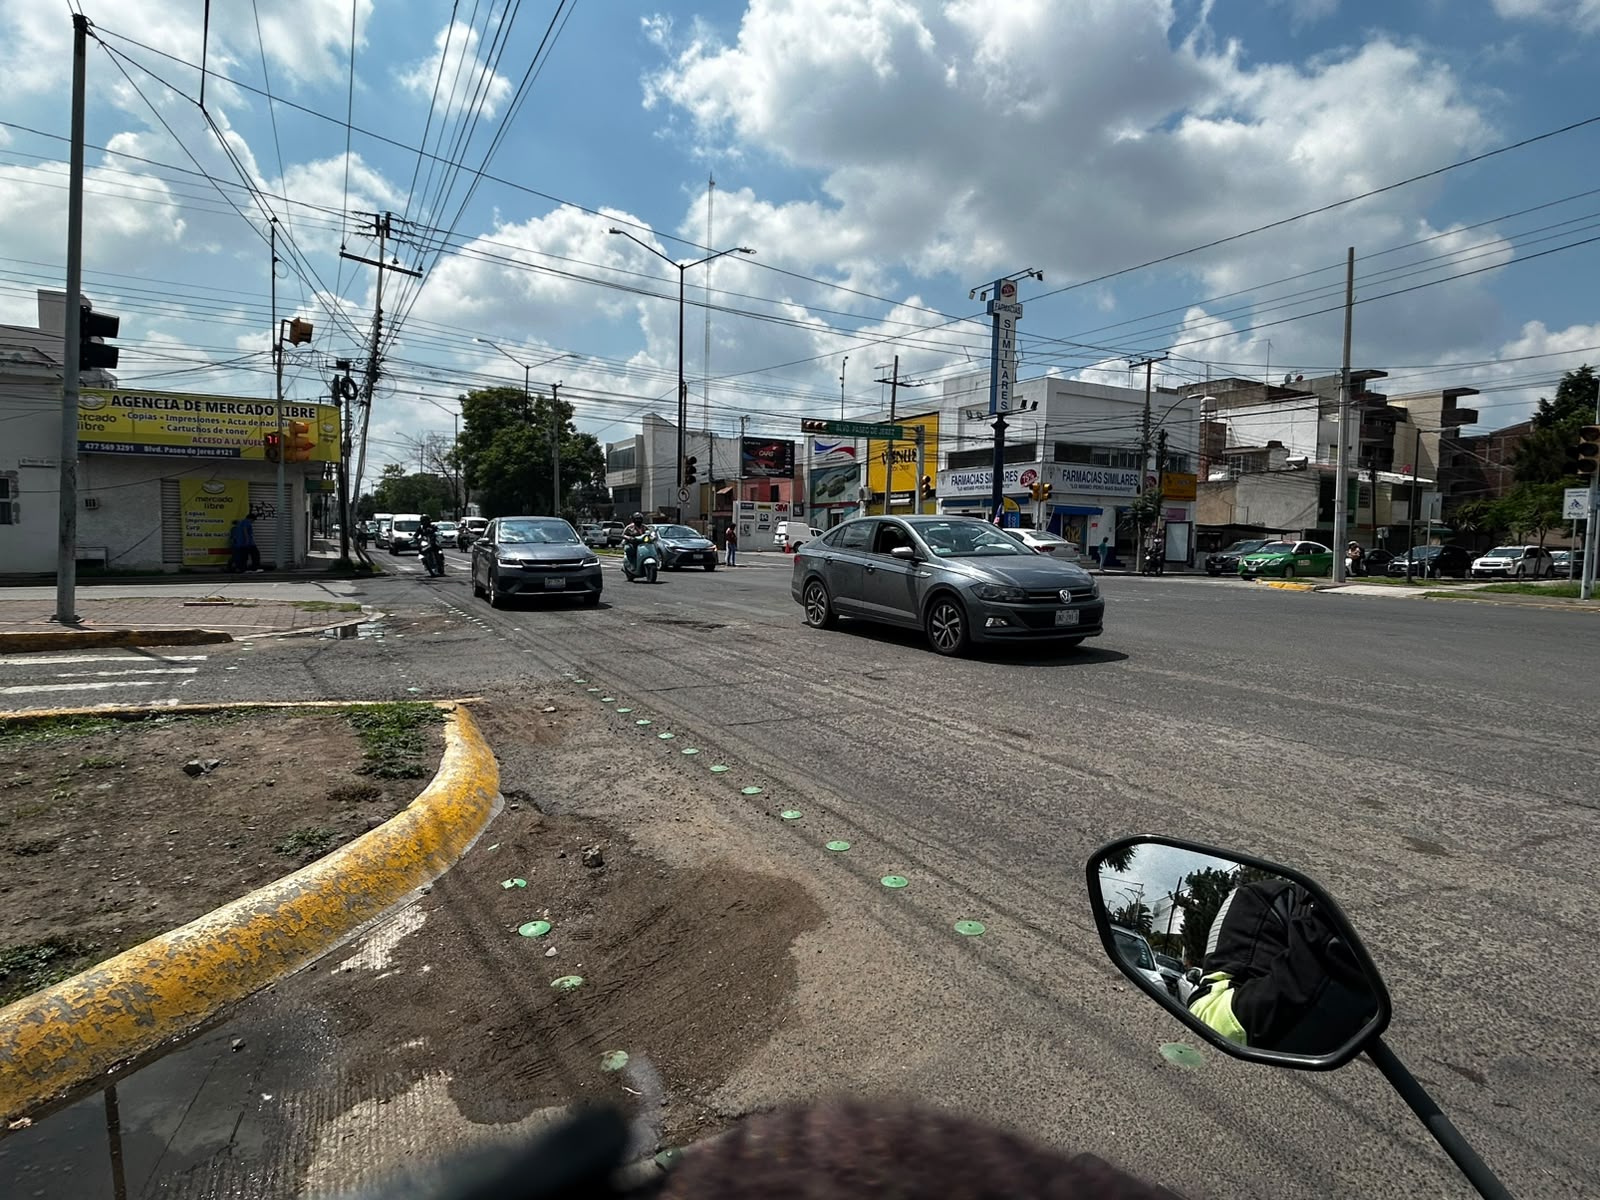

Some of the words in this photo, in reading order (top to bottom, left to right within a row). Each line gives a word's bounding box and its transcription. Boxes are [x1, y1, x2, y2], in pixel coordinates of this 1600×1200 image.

[994, 302, 1021, 315] FARMACIAS
[1000, 319, 1012, 411] SIMILARES
[111, 395, 180, 411] AGENCIA
[184, 400, 202, 412] DE
[205, 402, 274, 416] MERCADO
[77, 413, 117, 423] ercado
[127, 412, 157, 421] Copias
[165, 414, 220, 425] Impresiones
[227, 417, 246, 426] Acta
[248, 418, 258, 426] de
[167, 424, 212, 435] Cartuchos
[213, 426, 223, 434] de
[226, 427, 248, 436] toner
[84, 442, 100, 450] 477
[192, 436, 223, 445] ACCESO
[231, 437, 241, 445] LA
[143, 445, 163, 453] Blvd.
[164, 446, 186, 454] Paseo
[951, 473, 984, 487] FARMACIAS
[1062, 469, 1102, 483] FARMACIAS
[1103, 472, 1138, 486] SIMILARES
[775, 504, 788, 512] 3M
